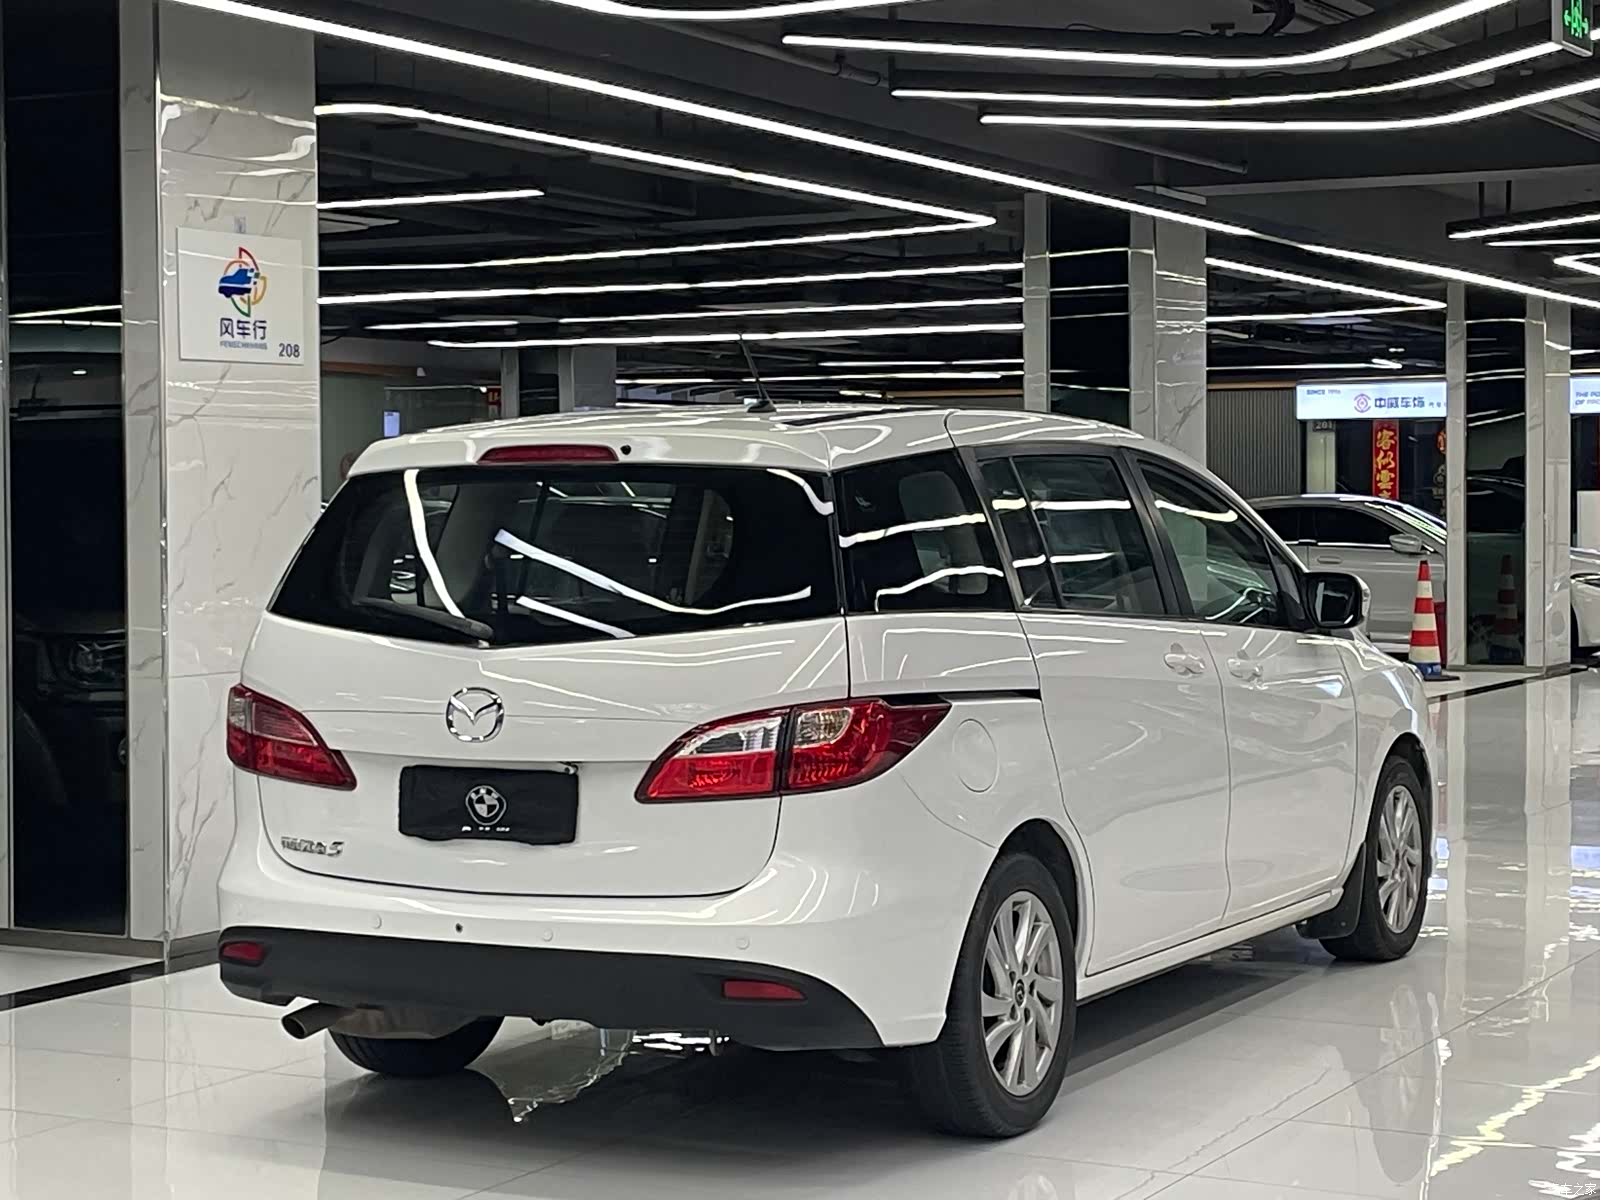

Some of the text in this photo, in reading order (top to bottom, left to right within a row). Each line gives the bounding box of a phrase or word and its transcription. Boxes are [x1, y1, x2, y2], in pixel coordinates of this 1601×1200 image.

[219, 317, 267, 340] 风车行
[278, 343, 300, 358] 208
